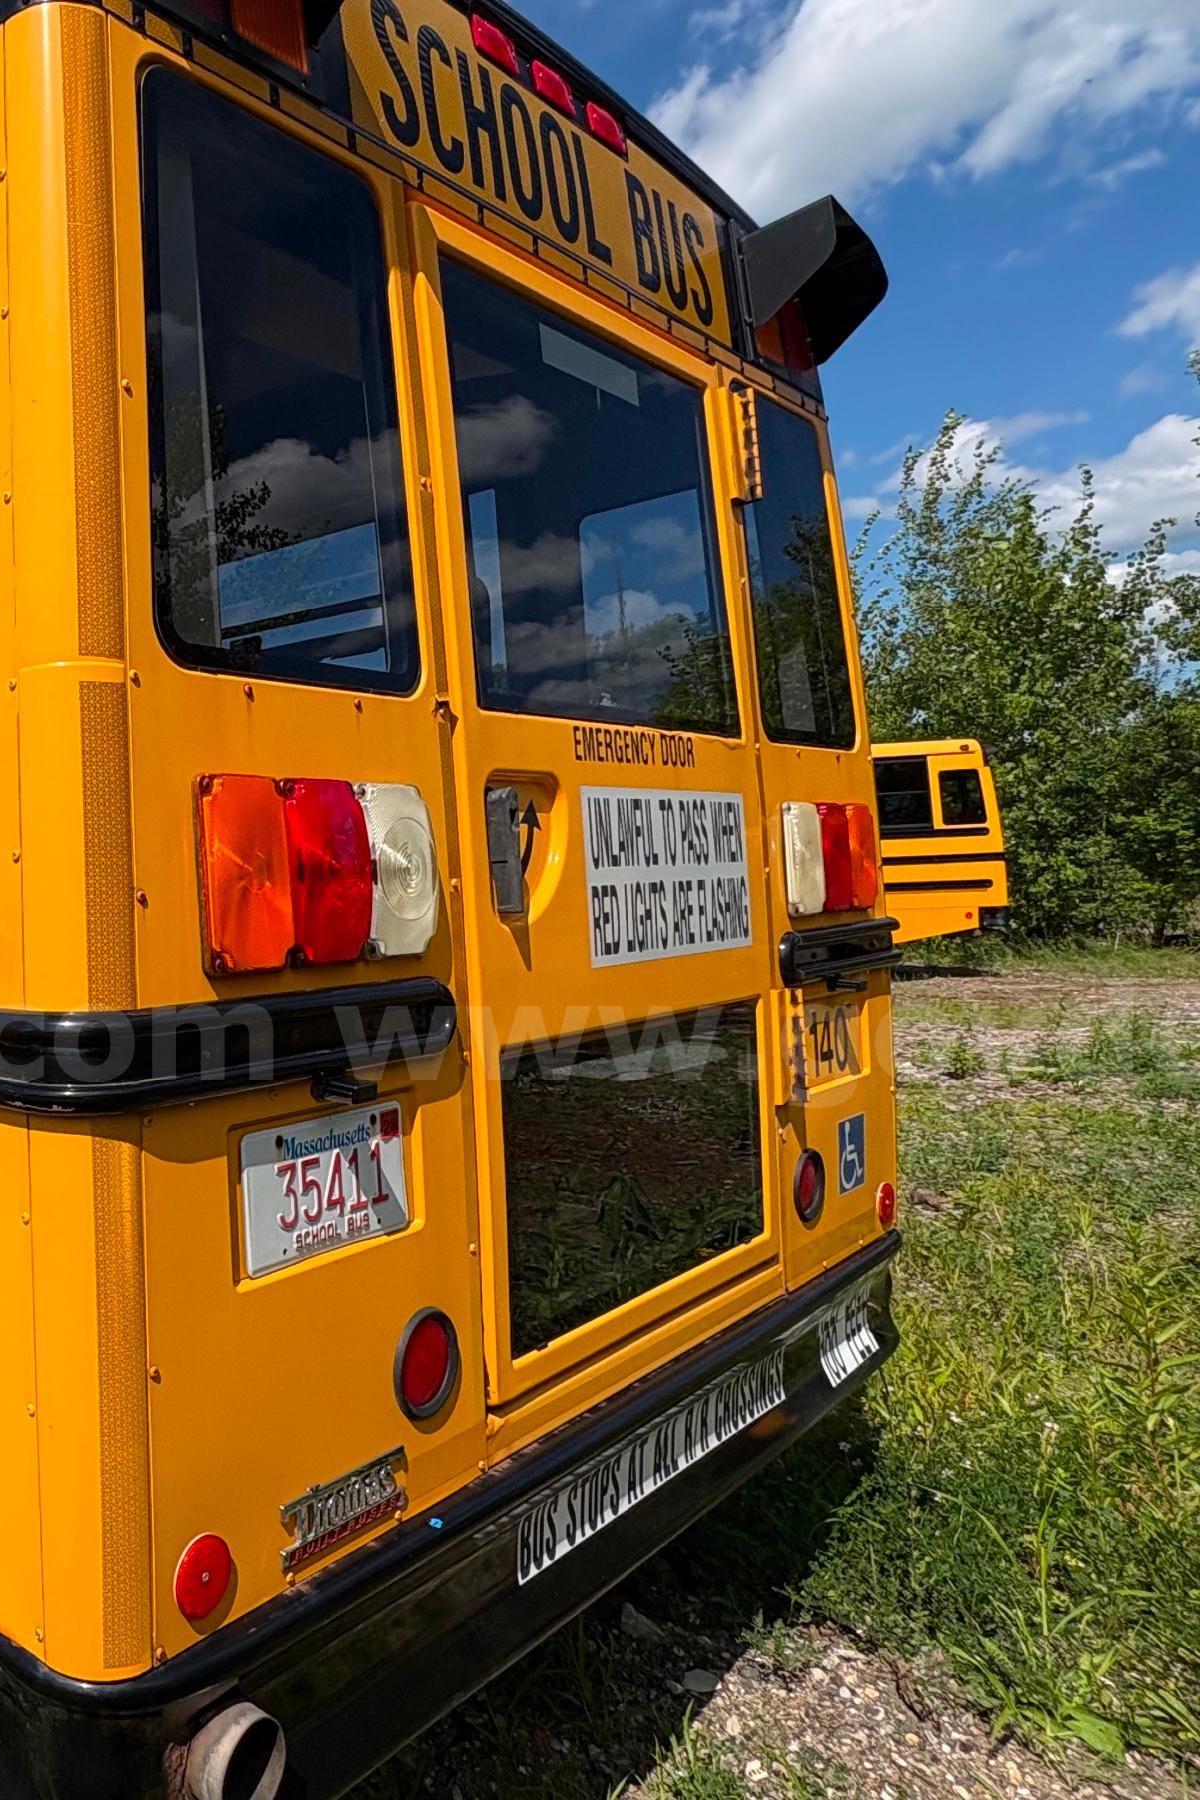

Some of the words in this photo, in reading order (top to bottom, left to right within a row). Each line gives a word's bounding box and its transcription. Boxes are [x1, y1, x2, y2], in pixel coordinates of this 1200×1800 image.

[371, 0, 612, 267] SCHOOL
[624, 168, 713, 326] BUS
[573, 725, 655, 766] EMERGENCY
[659, 733, 695, 768] DOOR
[587, 797, 658, 870] UNLAWFUL
[659, 798, 677, 867] TO
[679, 798, 709, 866] PASS
[710, 801, 743, 863] WHEN
[591, 884, 621, 957] RED
[624, 880, 668, 953] LIGHTS
[672, 880, 695, 947] ARE
[697, 875, 749, 943] FLASHING
[809, 1007, 849, 1079] 140
[282, 1123, 371, 1161] Massachusetts
[274, 1140, 390, 1231] 35411
[294, 1220, 342, 1249] SCHOOL
[346, 1211, 371, 1234] BUS
[519, 1494, 560, 1580] BUS
[566, 1453, 622, 1547] STOPS
[627, 1434, 650, 1505] AT
[653, 1416, 680, 1486] ALL
[714, 1348, 782, 1443] CROSSINGS
